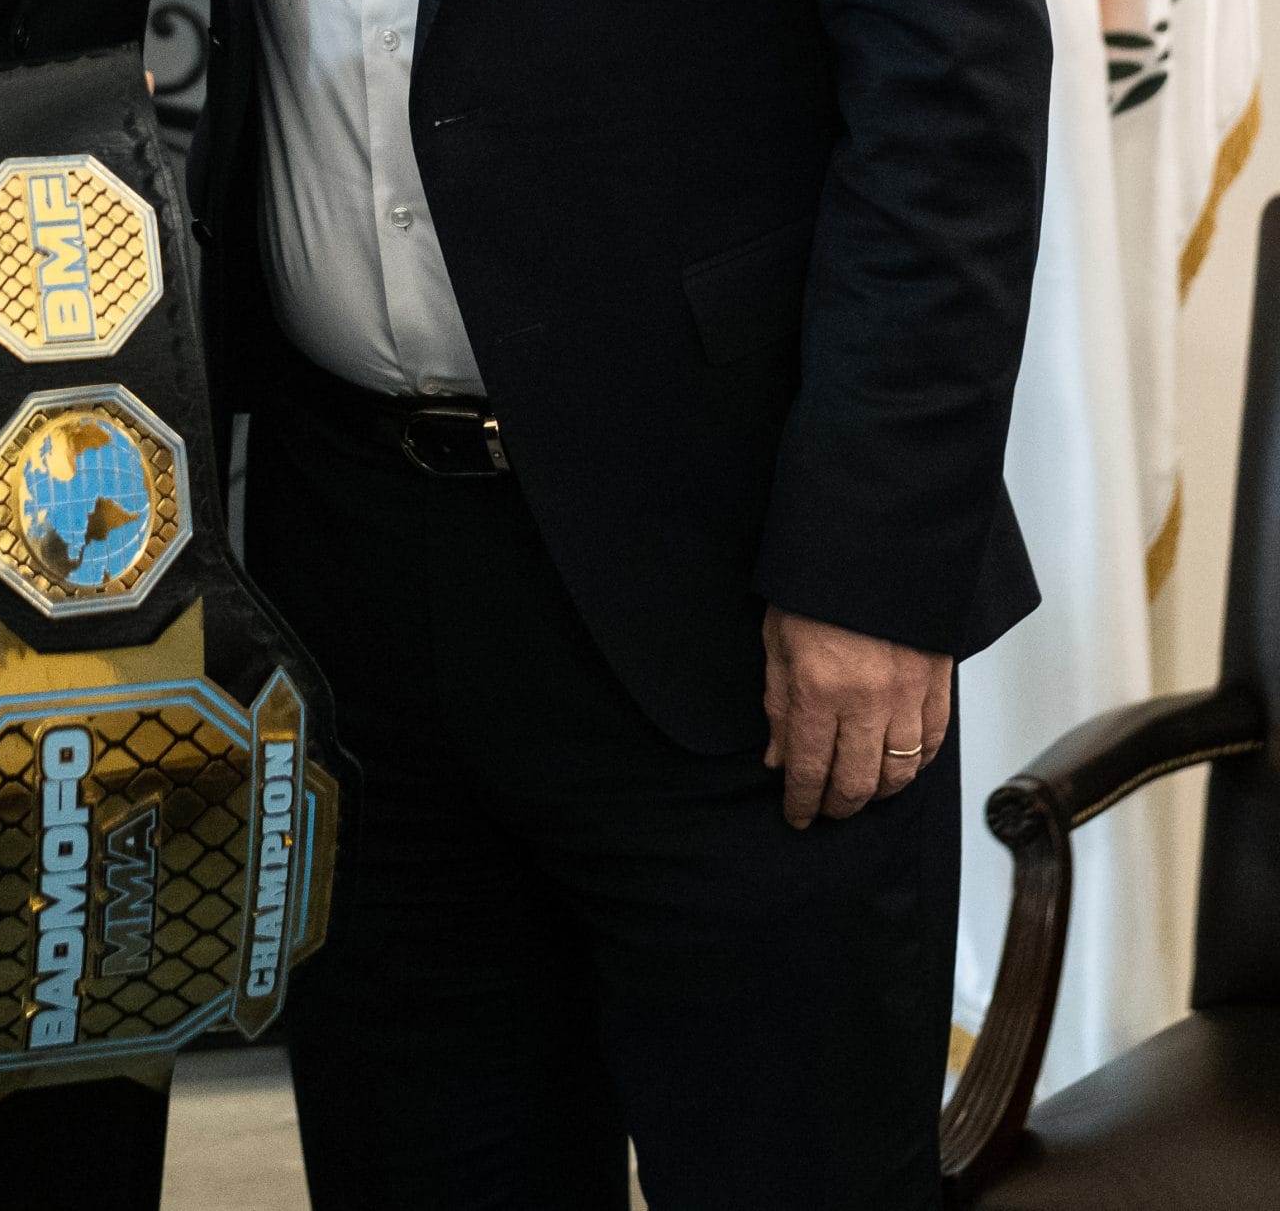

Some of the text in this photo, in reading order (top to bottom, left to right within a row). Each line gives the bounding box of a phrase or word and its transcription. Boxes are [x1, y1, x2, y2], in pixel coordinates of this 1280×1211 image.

[28, 172, 97, 343] BMF
[29, 728, 94, 1049] BADMOFO
[101, 807, 160, 978] MMA
[246, 740, 295, 997] CHAMPION
